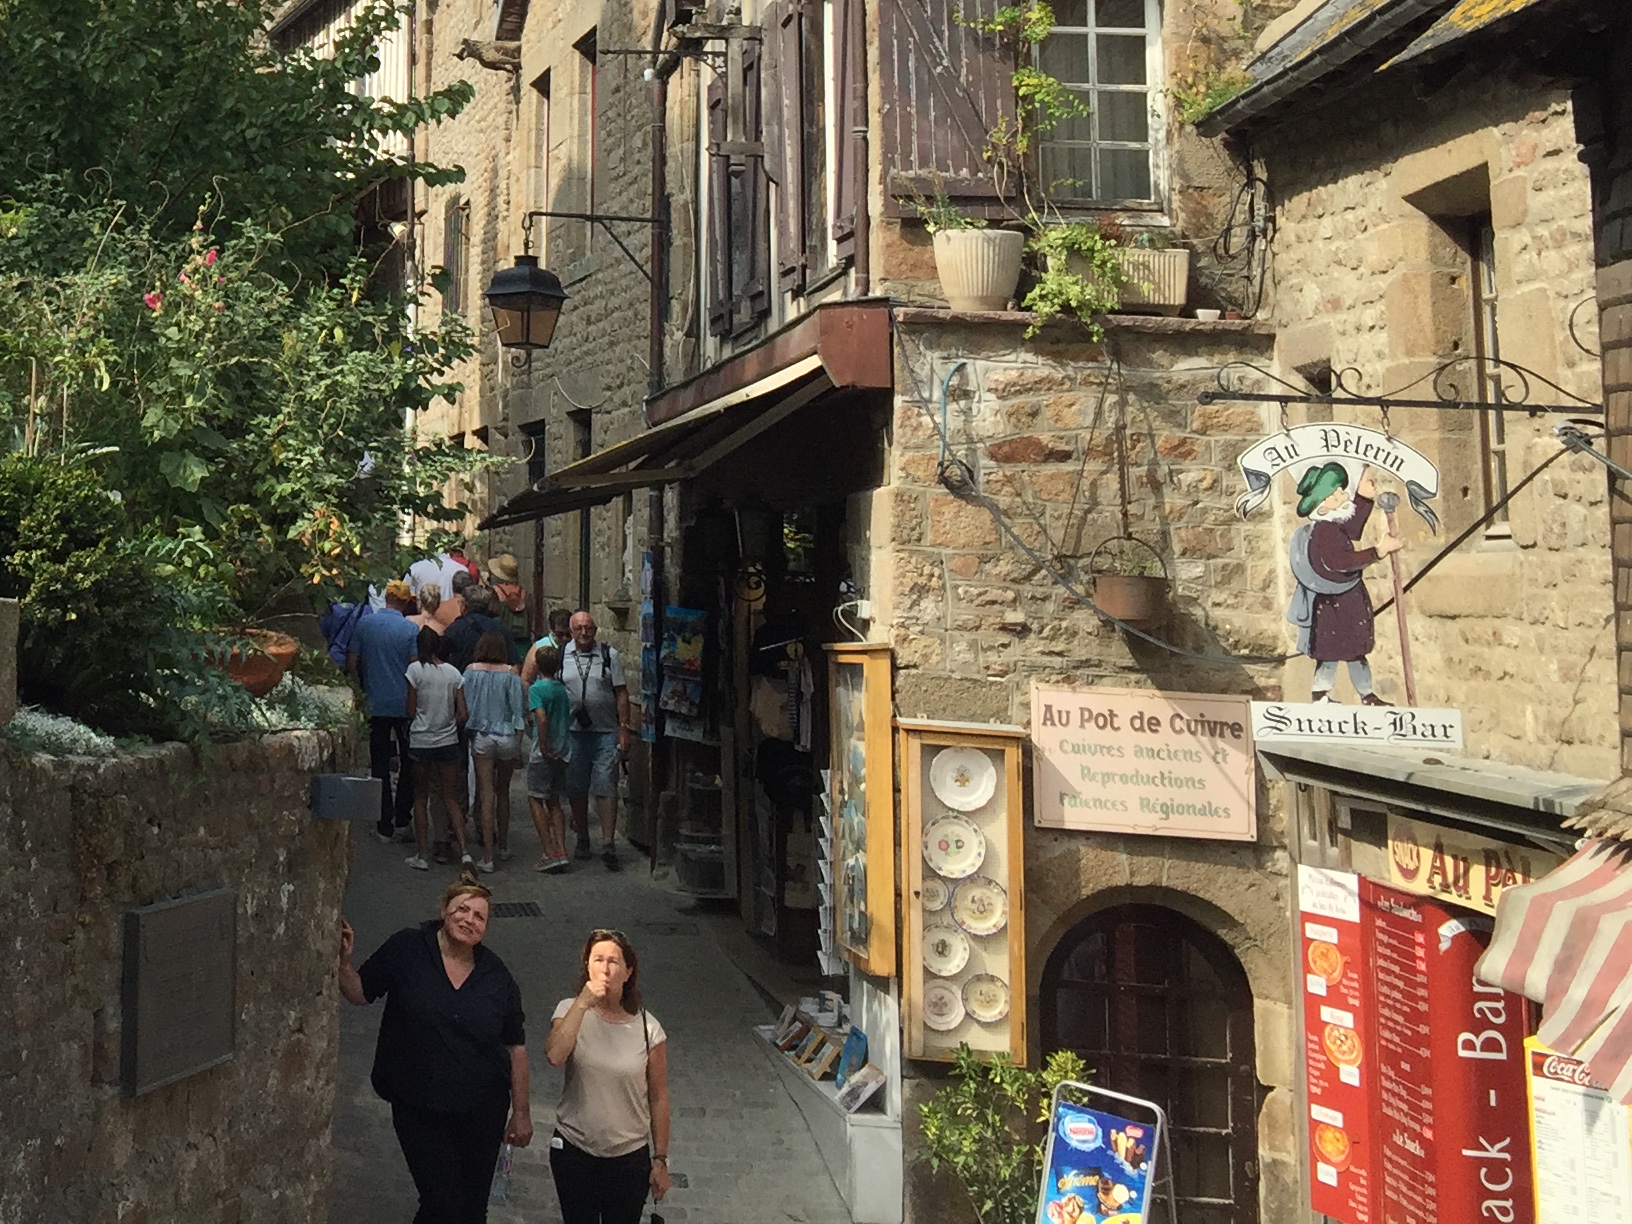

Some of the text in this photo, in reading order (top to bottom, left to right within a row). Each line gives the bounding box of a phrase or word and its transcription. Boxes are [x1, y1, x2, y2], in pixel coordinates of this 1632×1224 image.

[1262, 428, 1405, 472] Au Pèlerin
[1042, 703, 1244, 740] Au Pot de Cuivre
[1256, 705, 1455, 744] Snack-Bar
[1058, 738, 1230, 765] Cuivres anciens et
[1079, 763, 1207, 790] Reproductions
[1138, 796, 1231, 820] Régionales
[1426, 832, 1472, 901] Au
[1457, 975, 1508, 1060] Bar
